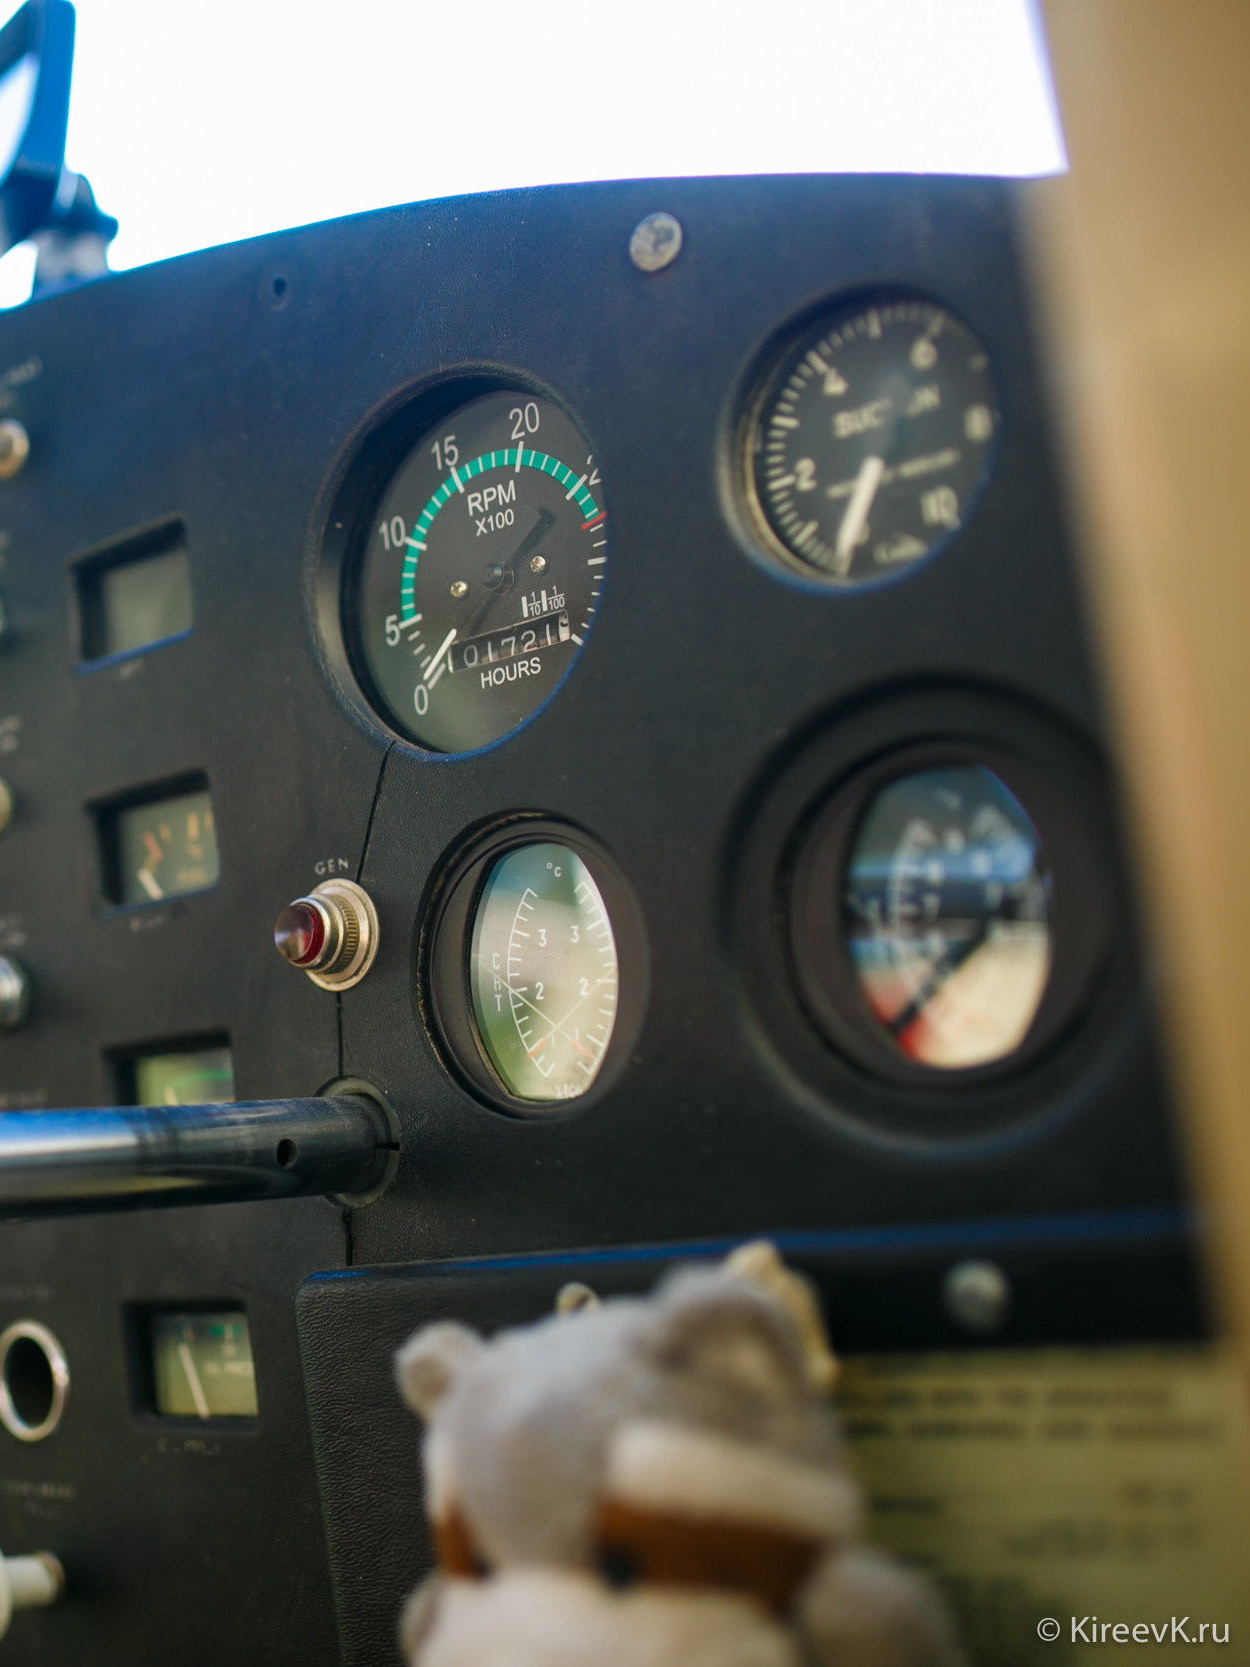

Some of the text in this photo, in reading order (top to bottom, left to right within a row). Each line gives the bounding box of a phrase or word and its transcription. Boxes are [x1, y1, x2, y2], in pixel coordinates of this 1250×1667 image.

[509, 402, 540, 439] 20
[431, 435, 459, 471] 15
[466, 480, 517, 517] RPM
[378, 516, 406, 551] 10
[475, 509, 515, 537] X100
[385, 615, 401, 647] 5
[480, 656, 542, 689] HOURS
[413, 684, 429, 716] 0
[314, 858, 349, 876] GEN
[537, 928, 548, 949] 3
[569, 924, 581, 944] 3
[535, 981, 546, 1001] 2
[578, 977, 590, 996] 2
